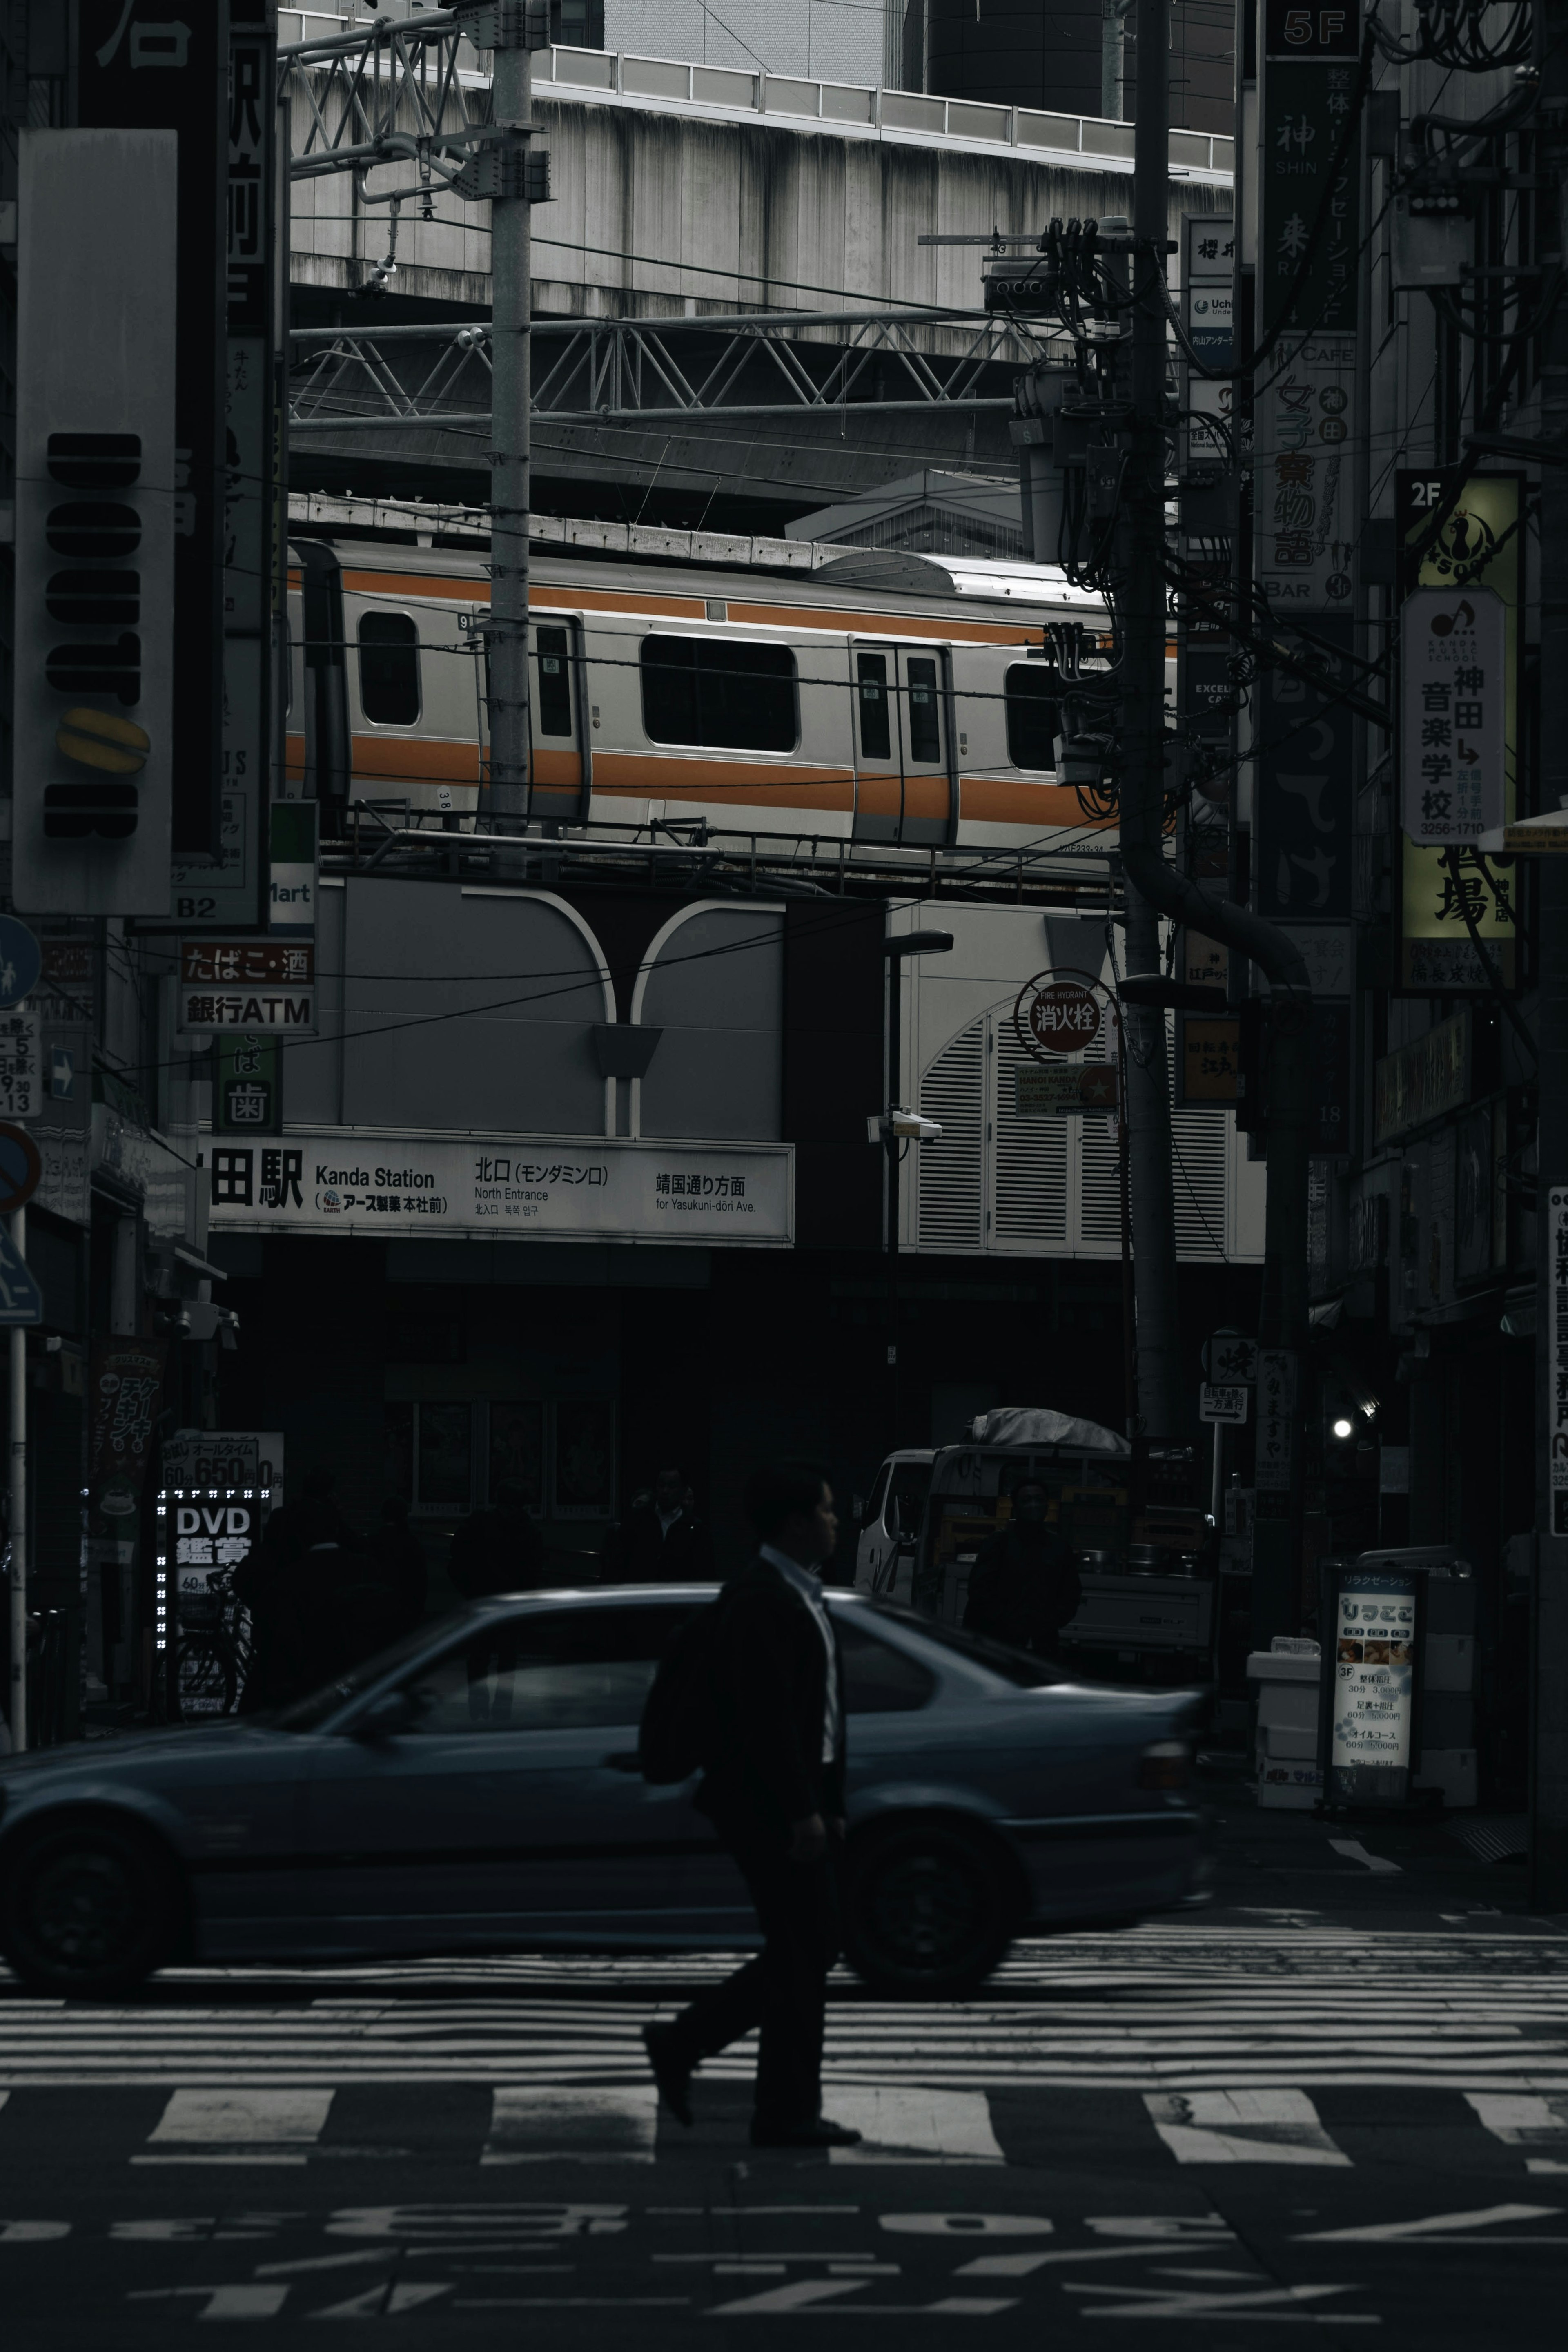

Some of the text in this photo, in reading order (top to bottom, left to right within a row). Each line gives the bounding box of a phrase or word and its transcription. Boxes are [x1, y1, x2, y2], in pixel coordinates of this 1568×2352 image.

[1284, 11, 1345, 44] 5F
[1277, 114, 1316, 156] 神
[1276, 162, 1317, 174] SHIN
[1301, 346, 1354, 363] CAFE
[233, 349, 249, 390] 牛たん
[1323, 389, 1345, 440] 神田
[1274, 374, 1315, 566] 女子寮物語
[1411, 482, 1441, 506] 2F
[1265, 582, 1310, 597] BAR
[460, 615, 467, 629] 9
[1454, 666, 1484, 729] 神田
[1421, 681, 1452, 820] 音楽学校
[1421, 823, 1484, 835] 3256-1710
[177, 898, 216, 918] B2
[187, 948, 309, 980] たばこ・酒
[1058, 991, 1087, 999] HYDRANT
[187, 995, 310, 1024] 銀行ATM
[1036, 1003, 1095, 1032] 消火栓
[229, 1082, 267, 1123] 歯
[197, 1148, 435, 1209] 田駅 Kanda Station
[475, 1157, 510, 1182] 北口
[475, 1187, 548, 1201] North Entrance
[656, 1173, 746, 1197] 靖国通り方面
[475, 1204, 498, 1215] 北入口
[523, 1204, 539, 1217] 입구
[656, 1199, 756, 1213] for Yasukuni-dōri Ave.
[1217, 1341, 1256, 1381] 焼
[1204, 1387, 1244, 1398] 自転車を除く
[1203, 1399, 1244, 1410] 一方通行
[193, 1444, 253, 1456] オールタイム
[165, 1458, 255, 1486] 60分 650円
[177, 1507, 251, 1534] DVD
[176, 1537, 252, 1564] 鑑賞
[1345, 1575, 1412, 1586] リラクゼーション
[1341, 1668, 1352, 1676] 3F
[1360, 1675, 1391, 1684] 整体指圧
[1348, 1685, 1402, 1694] 30分 3,000円
[1348, 1711, 1400, 1720] 60分 5,000円
[1352, 1730, 1396, 1740] オイルコース
[1370, 1741, 1399, 1750] 5,000円
